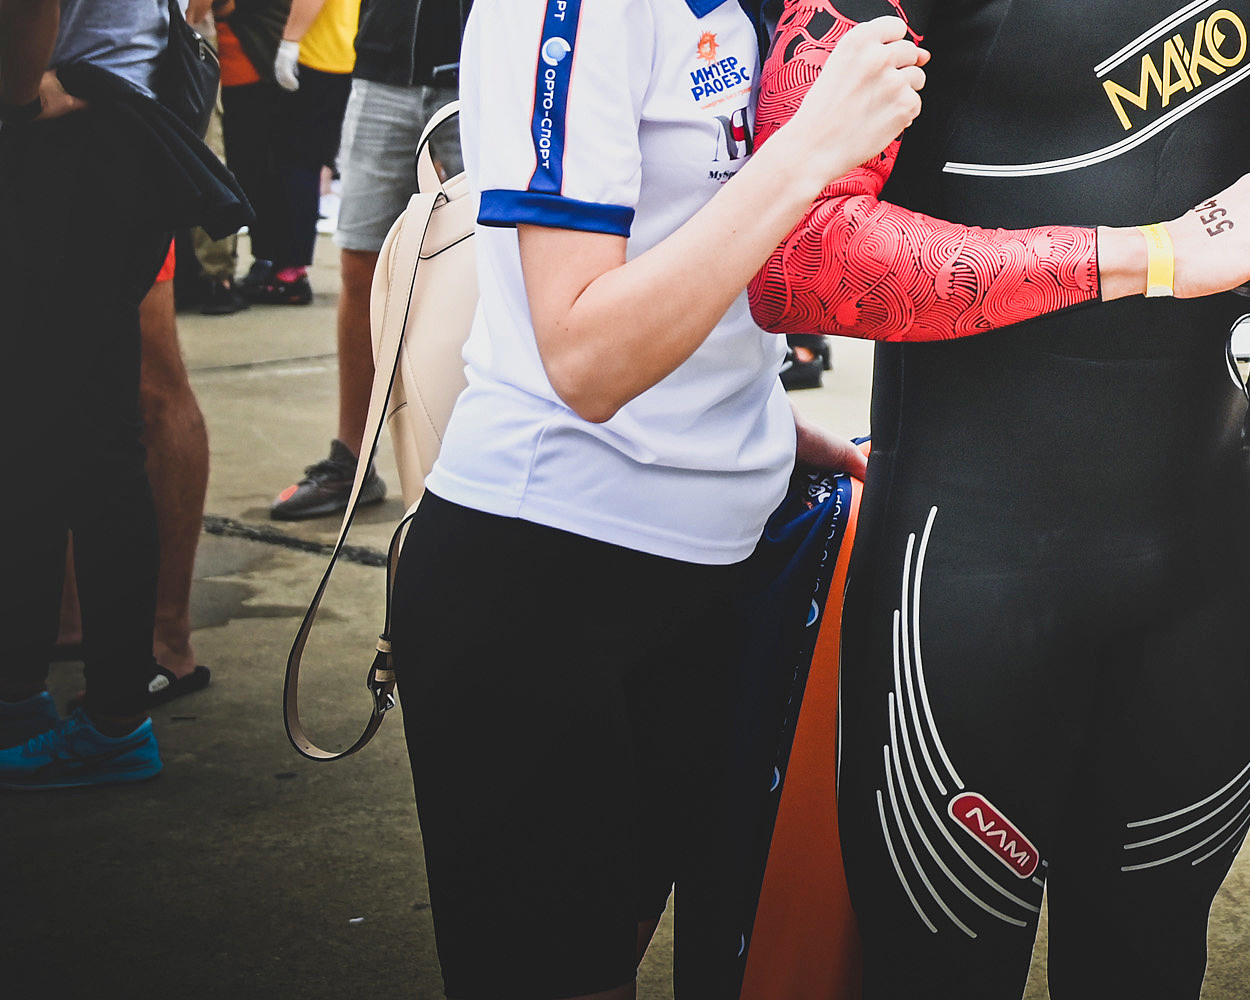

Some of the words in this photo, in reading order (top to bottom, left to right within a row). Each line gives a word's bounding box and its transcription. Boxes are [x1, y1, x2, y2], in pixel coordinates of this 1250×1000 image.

[690, 56, 738, 86] ИНТЕР
[1102, 9, 1247, 131] MAKO
[539, 69, 556, 169] ОРТО-СПОРТ
[965, 807, 1031, 867] NAMI
